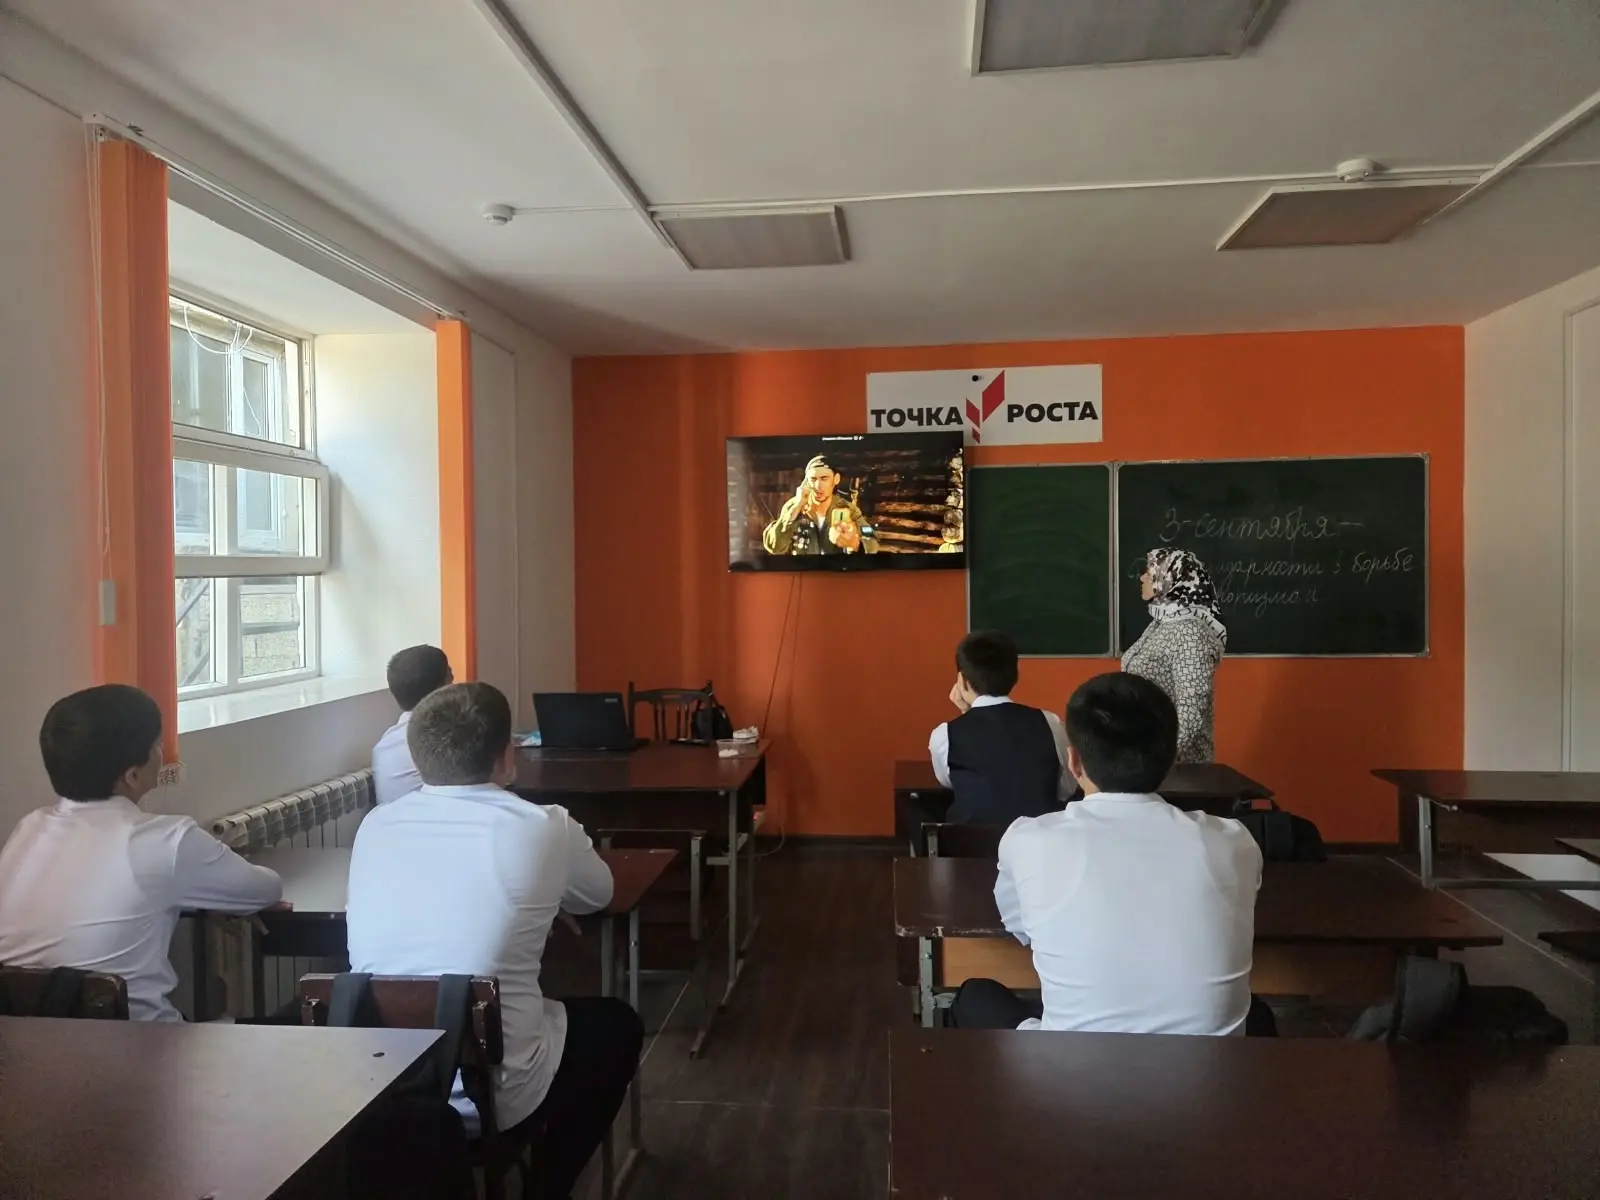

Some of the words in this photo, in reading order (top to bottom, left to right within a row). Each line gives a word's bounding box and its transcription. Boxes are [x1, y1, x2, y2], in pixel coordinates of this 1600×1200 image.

[870, 407, 964, 428] ТОЧКА
[1007, 401, 1099, 423] РОСТА
[1352, 545, 1415, 585] борьбе
